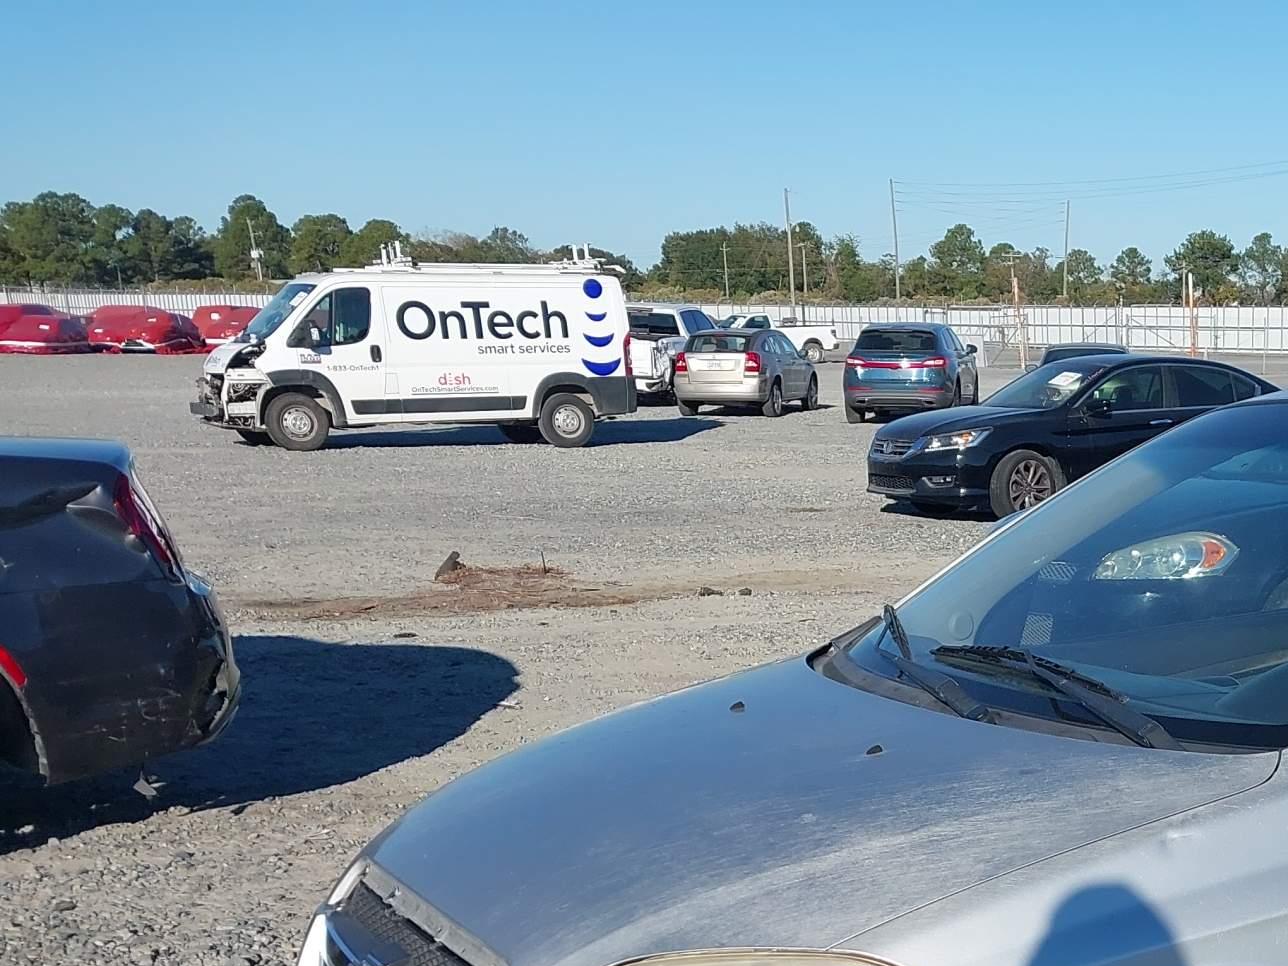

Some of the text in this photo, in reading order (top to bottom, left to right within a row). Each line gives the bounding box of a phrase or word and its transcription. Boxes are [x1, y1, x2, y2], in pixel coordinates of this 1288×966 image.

[396, 300, 569, 340] OnTech
[477, 342, 571, 355] smart services
[438, 372, 471, 386] dish
